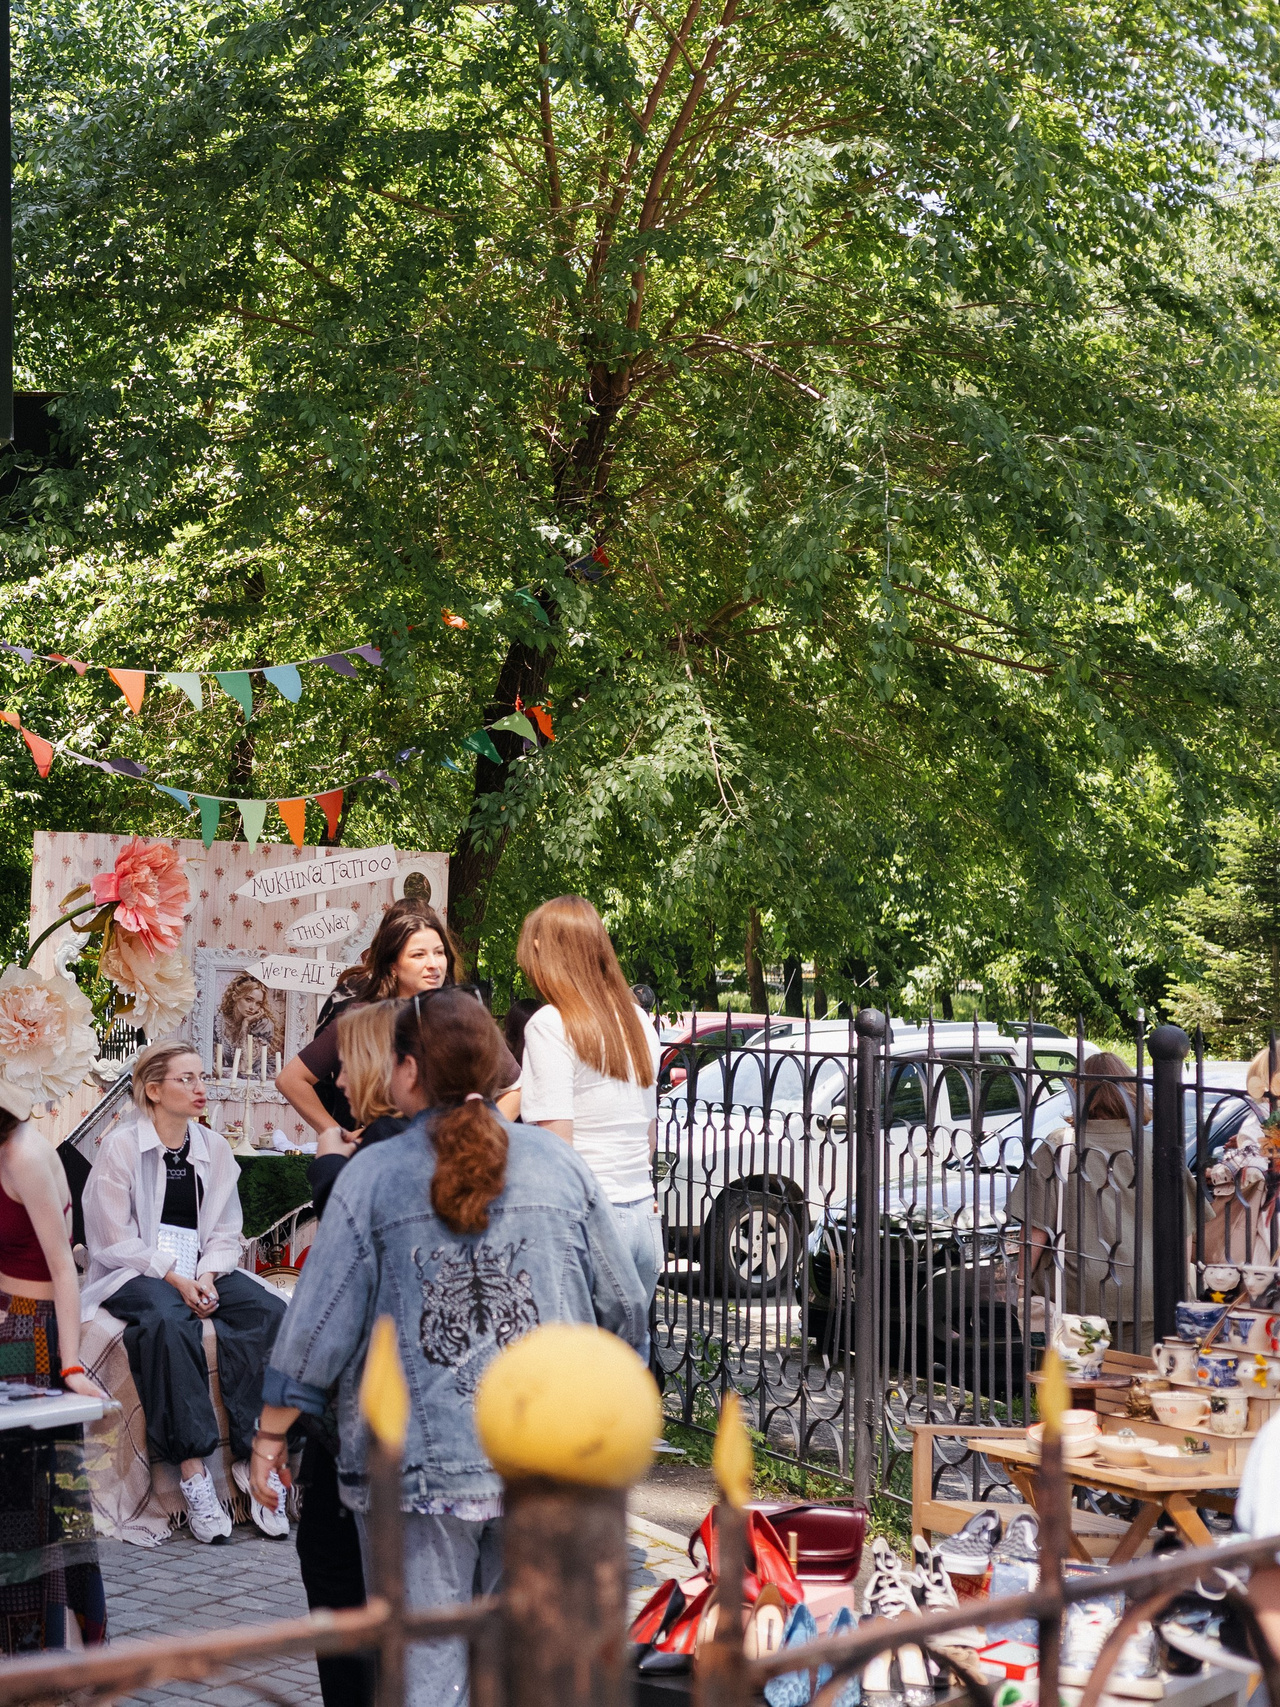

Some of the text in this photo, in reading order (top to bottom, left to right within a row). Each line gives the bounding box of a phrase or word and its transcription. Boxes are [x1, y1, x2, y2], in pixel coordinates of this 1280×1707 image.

[292, 922, 325, 940] THIS
[260, 961, 299, 980] We're
[300, 962, 325, 985] ALL
[275, 1279, 286, 1289] 12
